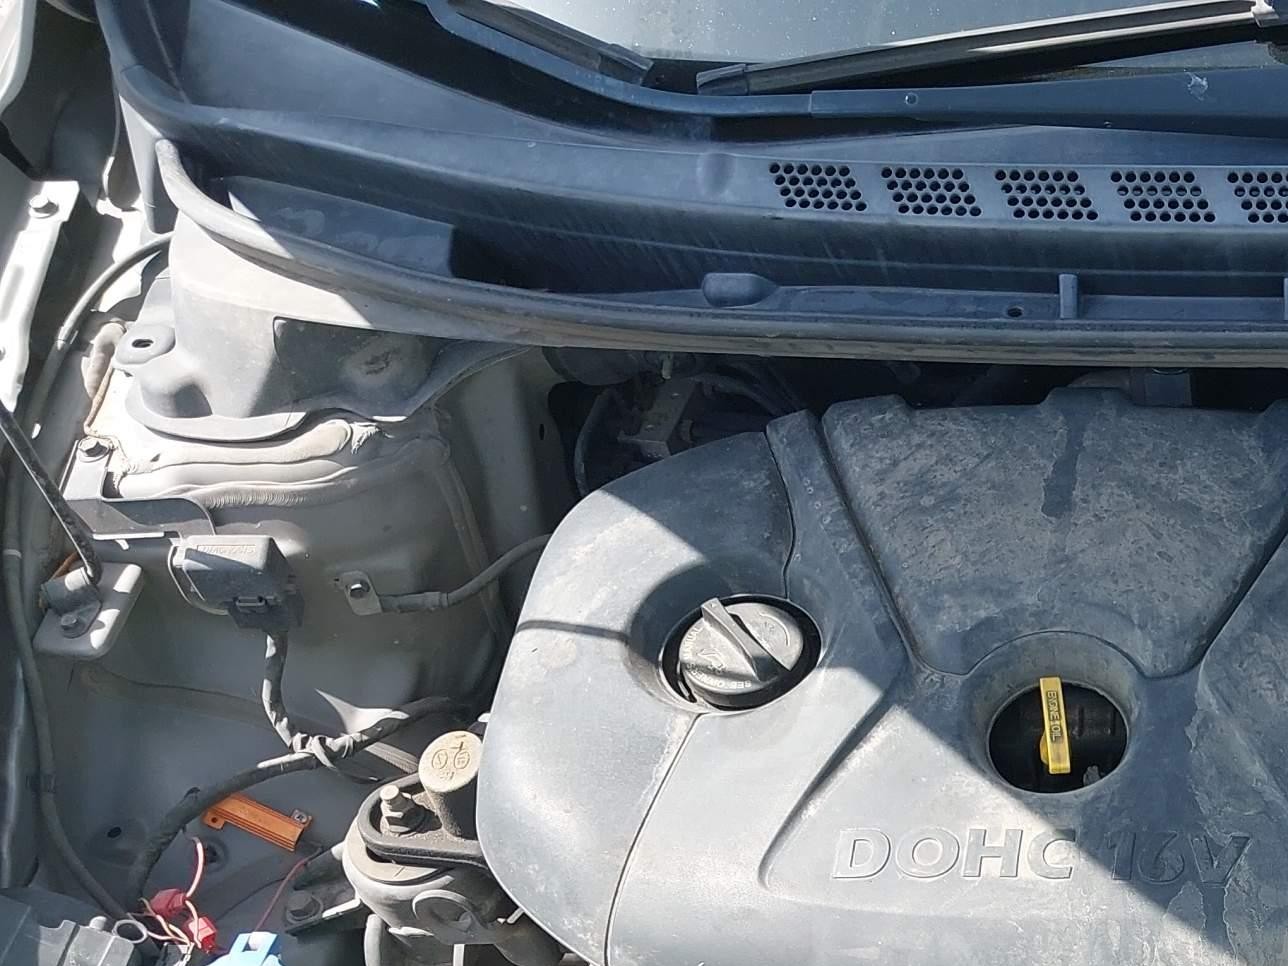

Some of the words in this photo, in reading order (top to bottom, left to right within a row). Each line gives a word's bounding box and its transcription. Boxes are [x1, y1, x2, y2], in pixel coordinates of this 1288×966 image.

[732, 680, 752, 689] SEE
[1047, 691, 1060, 720] ENGINE
[1051, 725, 1061, 741] OIL
[831, 827, 1076, 880] DOHC
[1106, 830, 1253, 887] 16V
